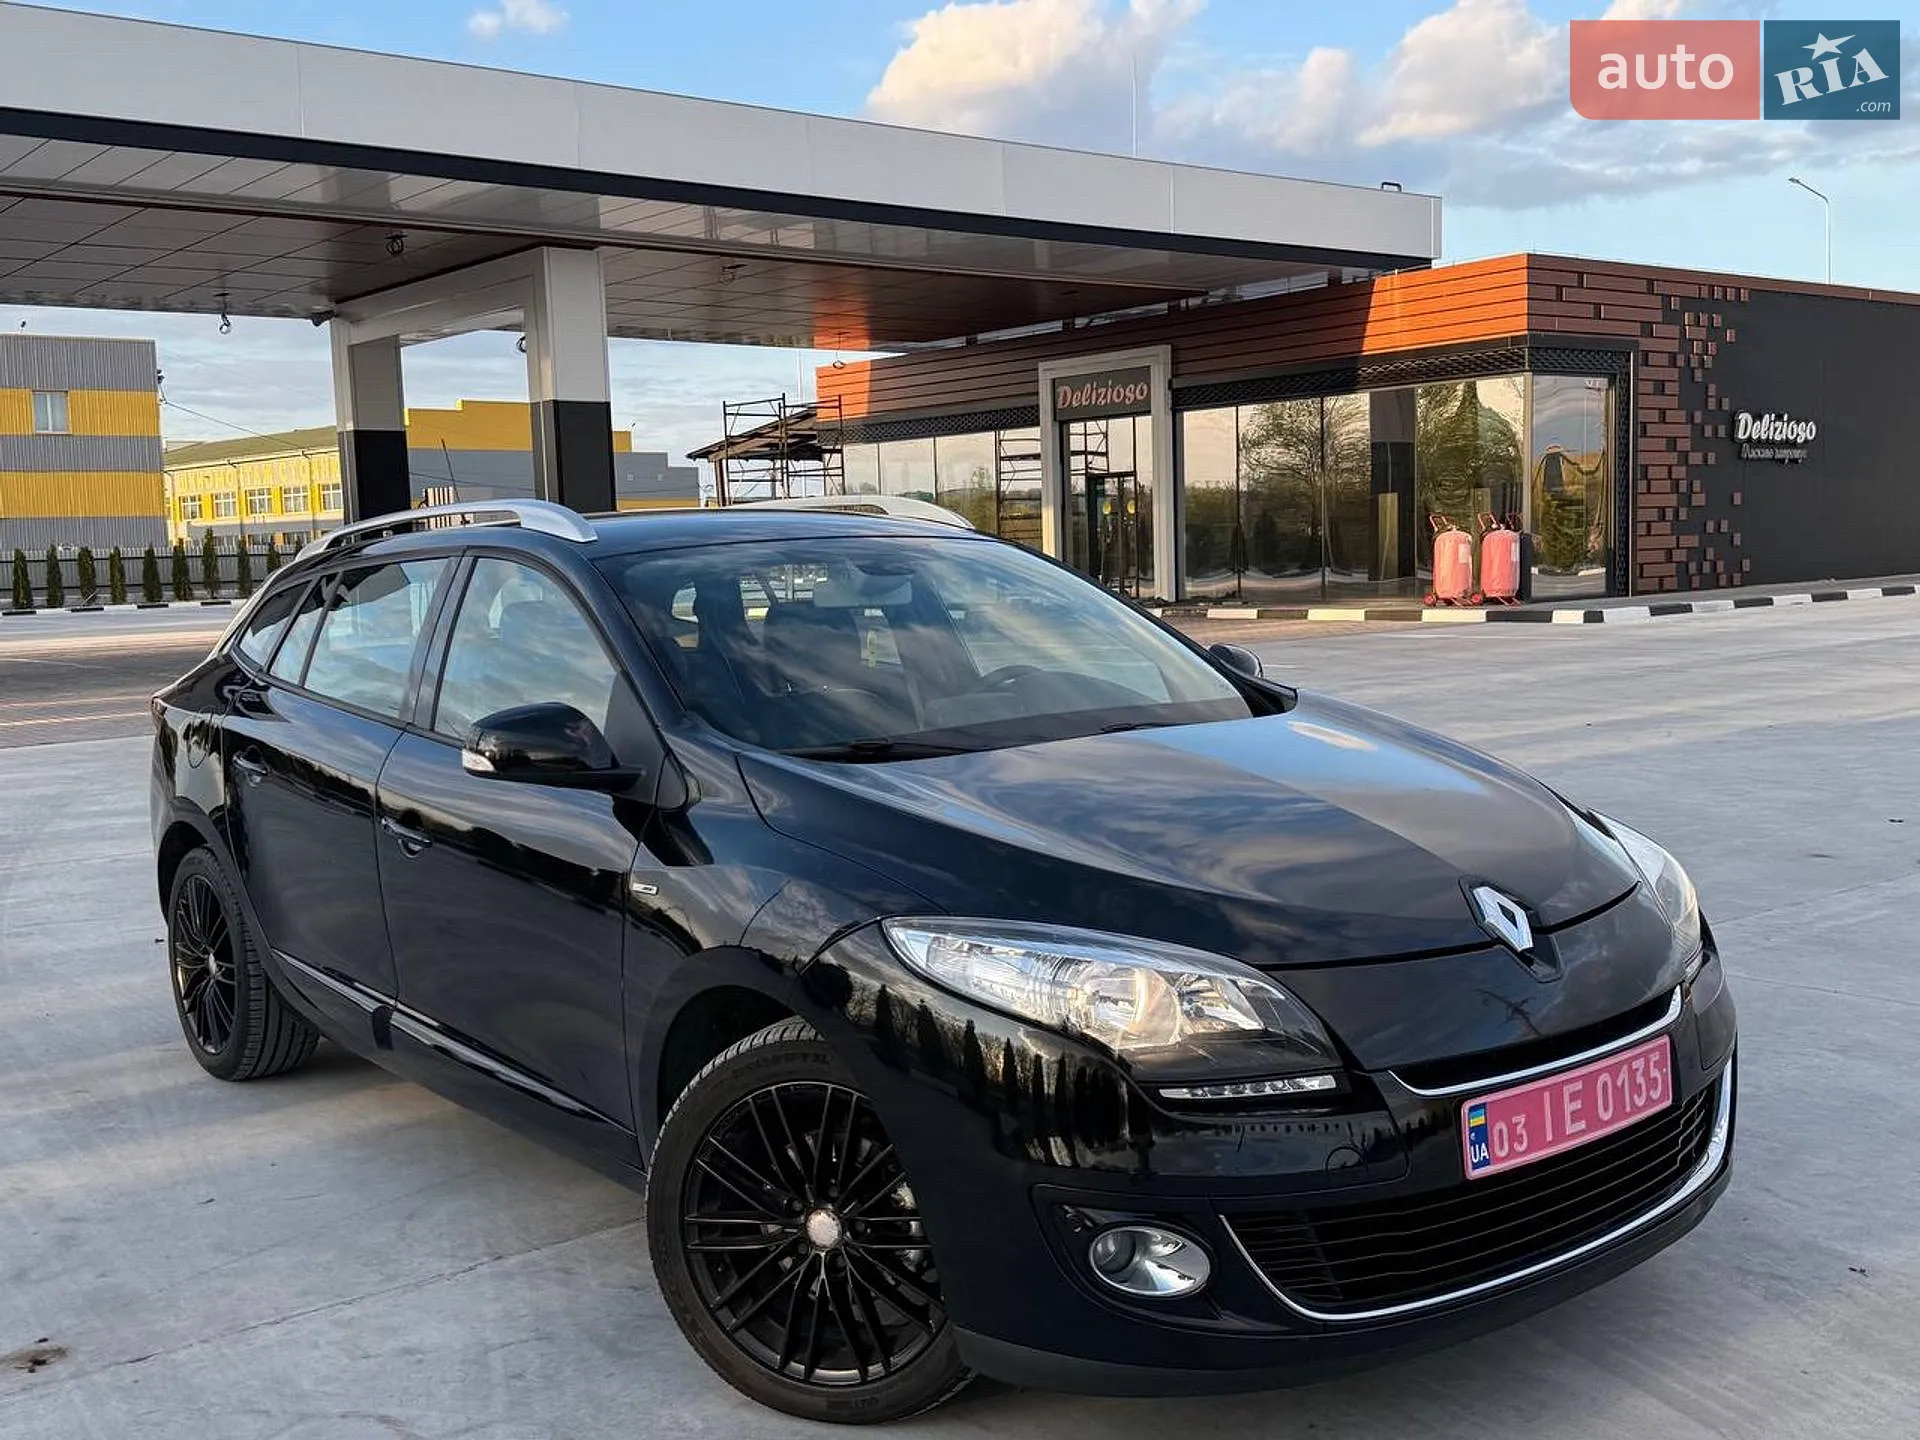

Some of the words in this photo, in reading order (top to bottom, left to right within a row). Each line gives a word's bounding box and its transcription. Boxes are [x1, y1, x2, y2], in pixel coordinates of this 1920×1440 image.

[1057, 380, 1149, 409] Delizioso
[1737, 411, 1817, 443] Delizioso
[1492, 1113, 1529, 1158] 03
[1543, 1080, 1586, 1142] IE
[1596, 1052, 1663, 1121] 0135
[1470, 1142, 1490, 1164] UA
